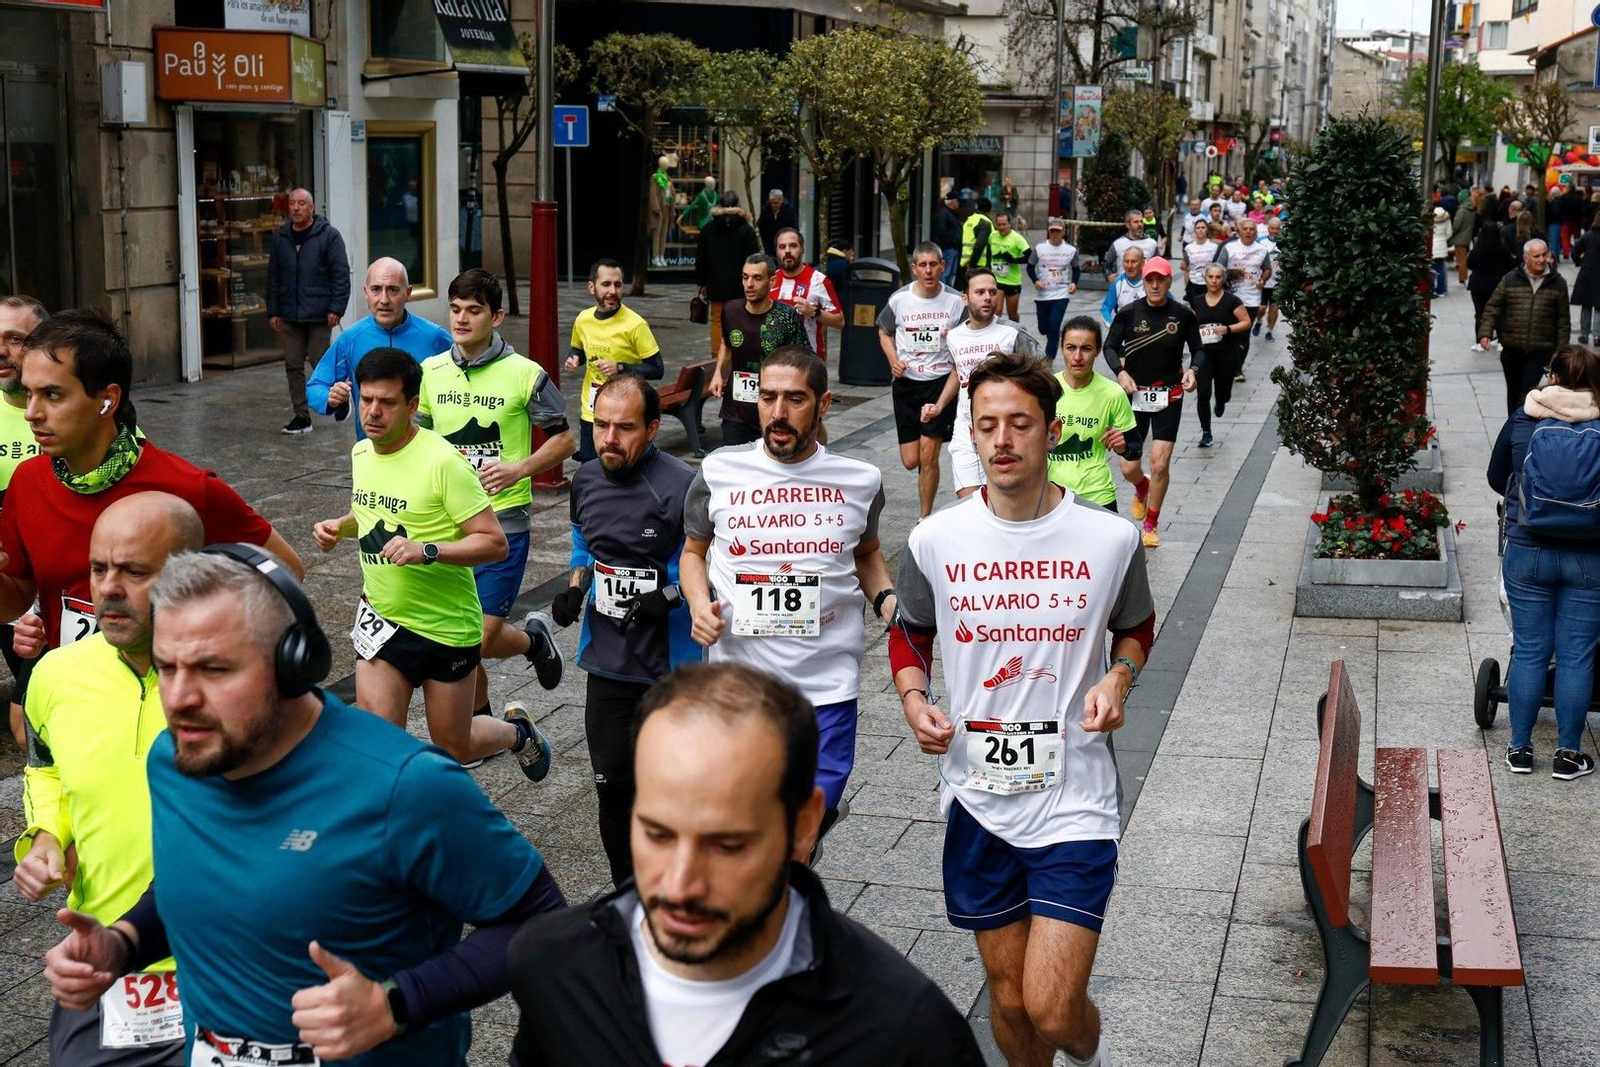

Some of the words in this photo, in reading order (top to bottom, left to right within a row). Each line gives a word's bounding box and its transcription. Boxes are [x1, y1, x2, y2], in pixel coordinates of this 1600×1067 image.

[233, 54, 264, 77] Oli
[239, 84, 252, 92] pan
[260, 83, 284, 93] contigo
[901, 314, 910, 322] VI
[911, 312, 950, 321] CARREIRA
[912, 332, 933, 342] 146
[958, 343, 1001, 356] CARREIRA
[742, 379, 760, 391] 19
[437, 390, 462, 405] máis
[463, 392, 471, 407] que
[473, 395, 505, 410] auga
[1143, 392, 1157, 402] 18
[1075, 416, 1099, 428] auga
[11, 441, 23, 459] que
[352, 488, 368, 506] áis
[369, 491, 377, 509] que
[378, 495, 408, 514] auga
[730, 491, 746, 505] VI
[751, 487, 845, 505] CARREIRA
[728, 513, 806, 529] CALVARIO
[750, 538, 845, 555] Santander
[945, 563, 966, 583] VI
[973, 560, 1091, 582] CARREIRA
[604, 577, 640, 599] 144
[751, 587, 802, 612] 118
[950, 593, 1040, 612] CALVARIO
[359, 607, 384, 637] 129
[976, 623, 1085, 642] Santander
[985, 735, 1035, 766] 261
[124, 971, 180, 1009] 528
